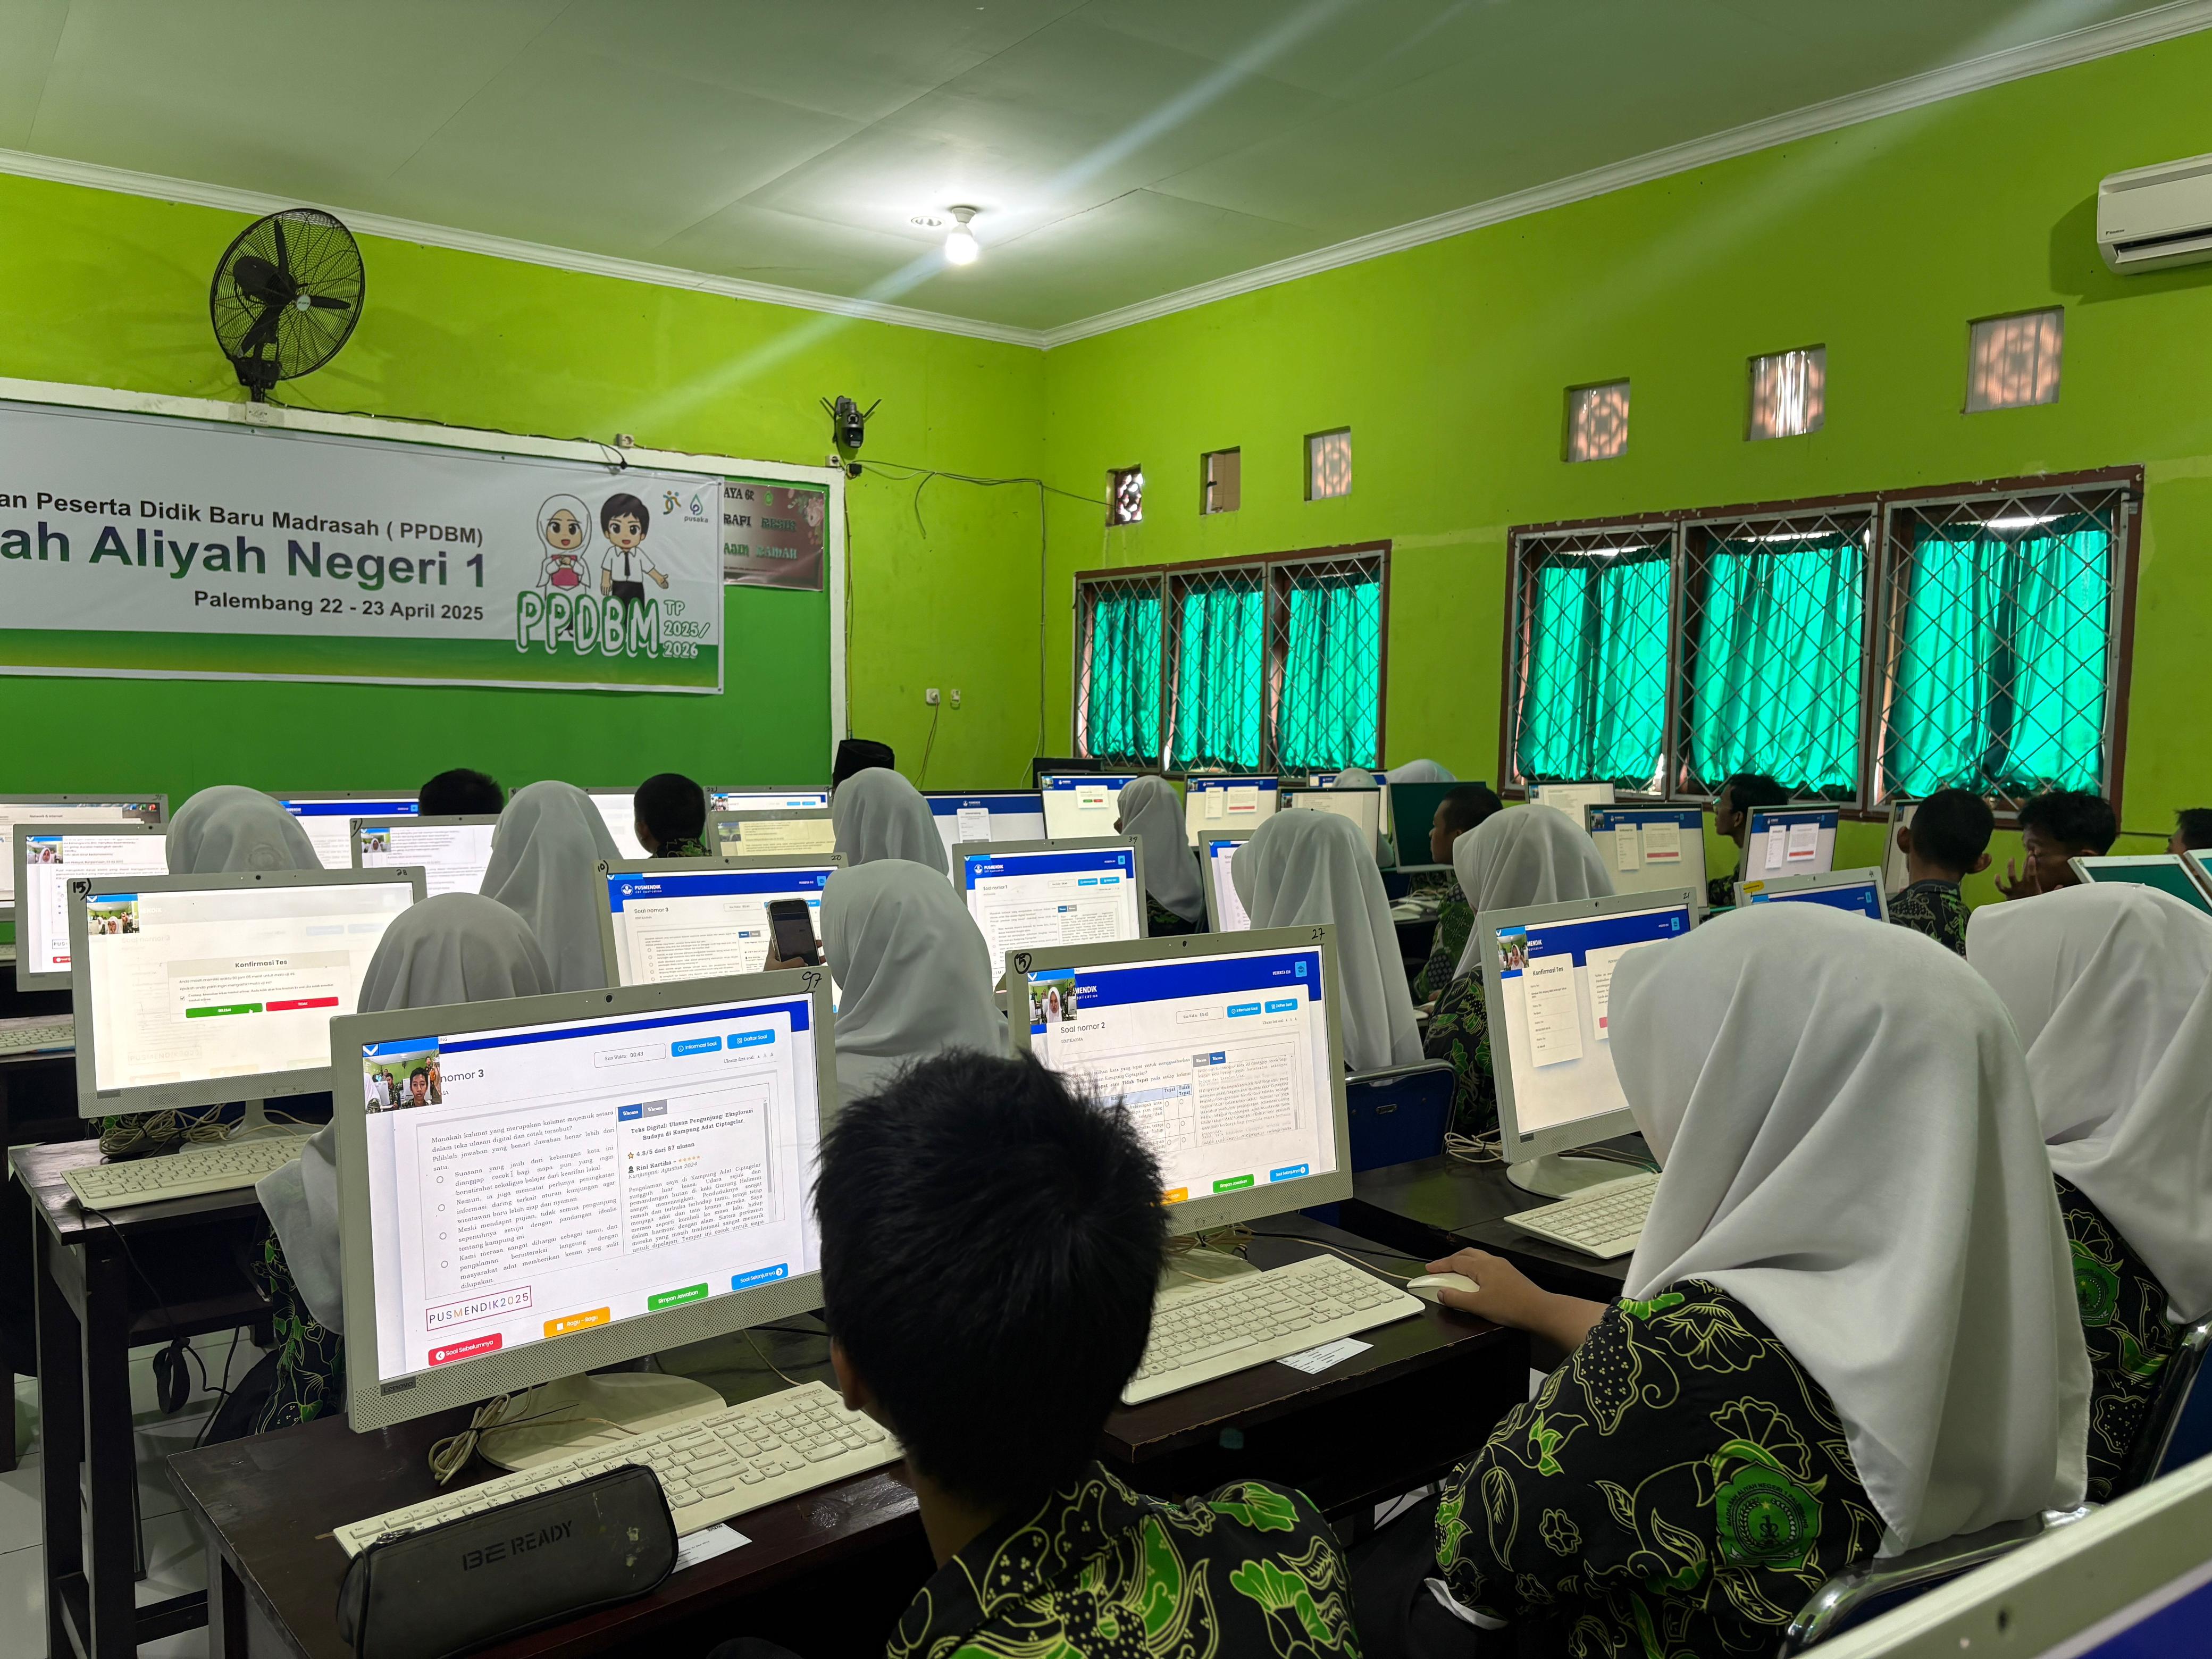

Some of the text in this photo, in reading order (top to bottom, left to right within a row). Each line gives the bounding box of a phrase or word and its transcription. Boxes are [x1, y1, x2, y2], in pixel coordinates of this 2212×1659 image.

[37, 492, 131, 516] Peserta
[140, 500, 202, 522] Didik
[210, 506, 264, 526] Baru
[272, 511, 379, 536] Madrasah
[400, 522, 483, 548] PPDBM)
[0, 521, 483, 591] ah Aliyah Negeri 1
[195, 590, 313, 616] Palembang
[320, 598, 343, 614] 22
[362, 600, 385, 616] 23
[390, 602, 434, 621] April
[441, 605, 483, 621] 2025
[664, 600, 685, 616] TP
[516, 590, 660, 658] PPDBM
[664, 620, 710, 639] 2025/
[663, 641, 698, 659] 2026
[1311, 927, 1326, 940] 27
[1532, 967, 1556, 976] Konfirmasi
[440, 1068, 484, 1083] nomor 3
[431, 1133, 462, 1143] Manakah
[463, 1130, 488, 1138] kalimat
[489, 1127, 505, 1136] yang
[506, 1122, 541, 1132] merupakan
[566, 1112, 594, 1122] majemuk
[646, 1122, 667, 1132] Digital:
[689, 1113, 724, 1124] Pengunjung:
[724, 1107, 753, 1118] Eksplorasi
[672, 1126, 700, 1135] Kampung
[715, 1118, 743, 1128] Ciptagelar
[492, 1134, 512, 1143] digital
[544, 1125, 573, 1135] tersebut?
[432, 1152, 457, 1162] Pilihlah
[460, 1149, 488, 1159] jawaban
[491, 1145, 507, 1154] yang
[510, 1141, 530, 1149] benar!
[533, 1137, 561, 1145] Jawaban
[627, 1169, 659, 1179] Kunjungan:
[660, 1164, 683, 1174] Agustus
[649, 1160, 672, 1169] Kartika
[750, 1270, 775, 1281] Selanjutnya
[657, 1289, 699, 1304] Simpan Jawaban
[429, 1292, 529, 1324] PUSMENDIK2025
[445, 1339, 493, 1356] Soal Sebelumnya
[383, 1381, 413, 1393] Lenovo
[784, 1388, 822, 1402] Lenovo
[462, 1520, 572, 1571] BE READY
